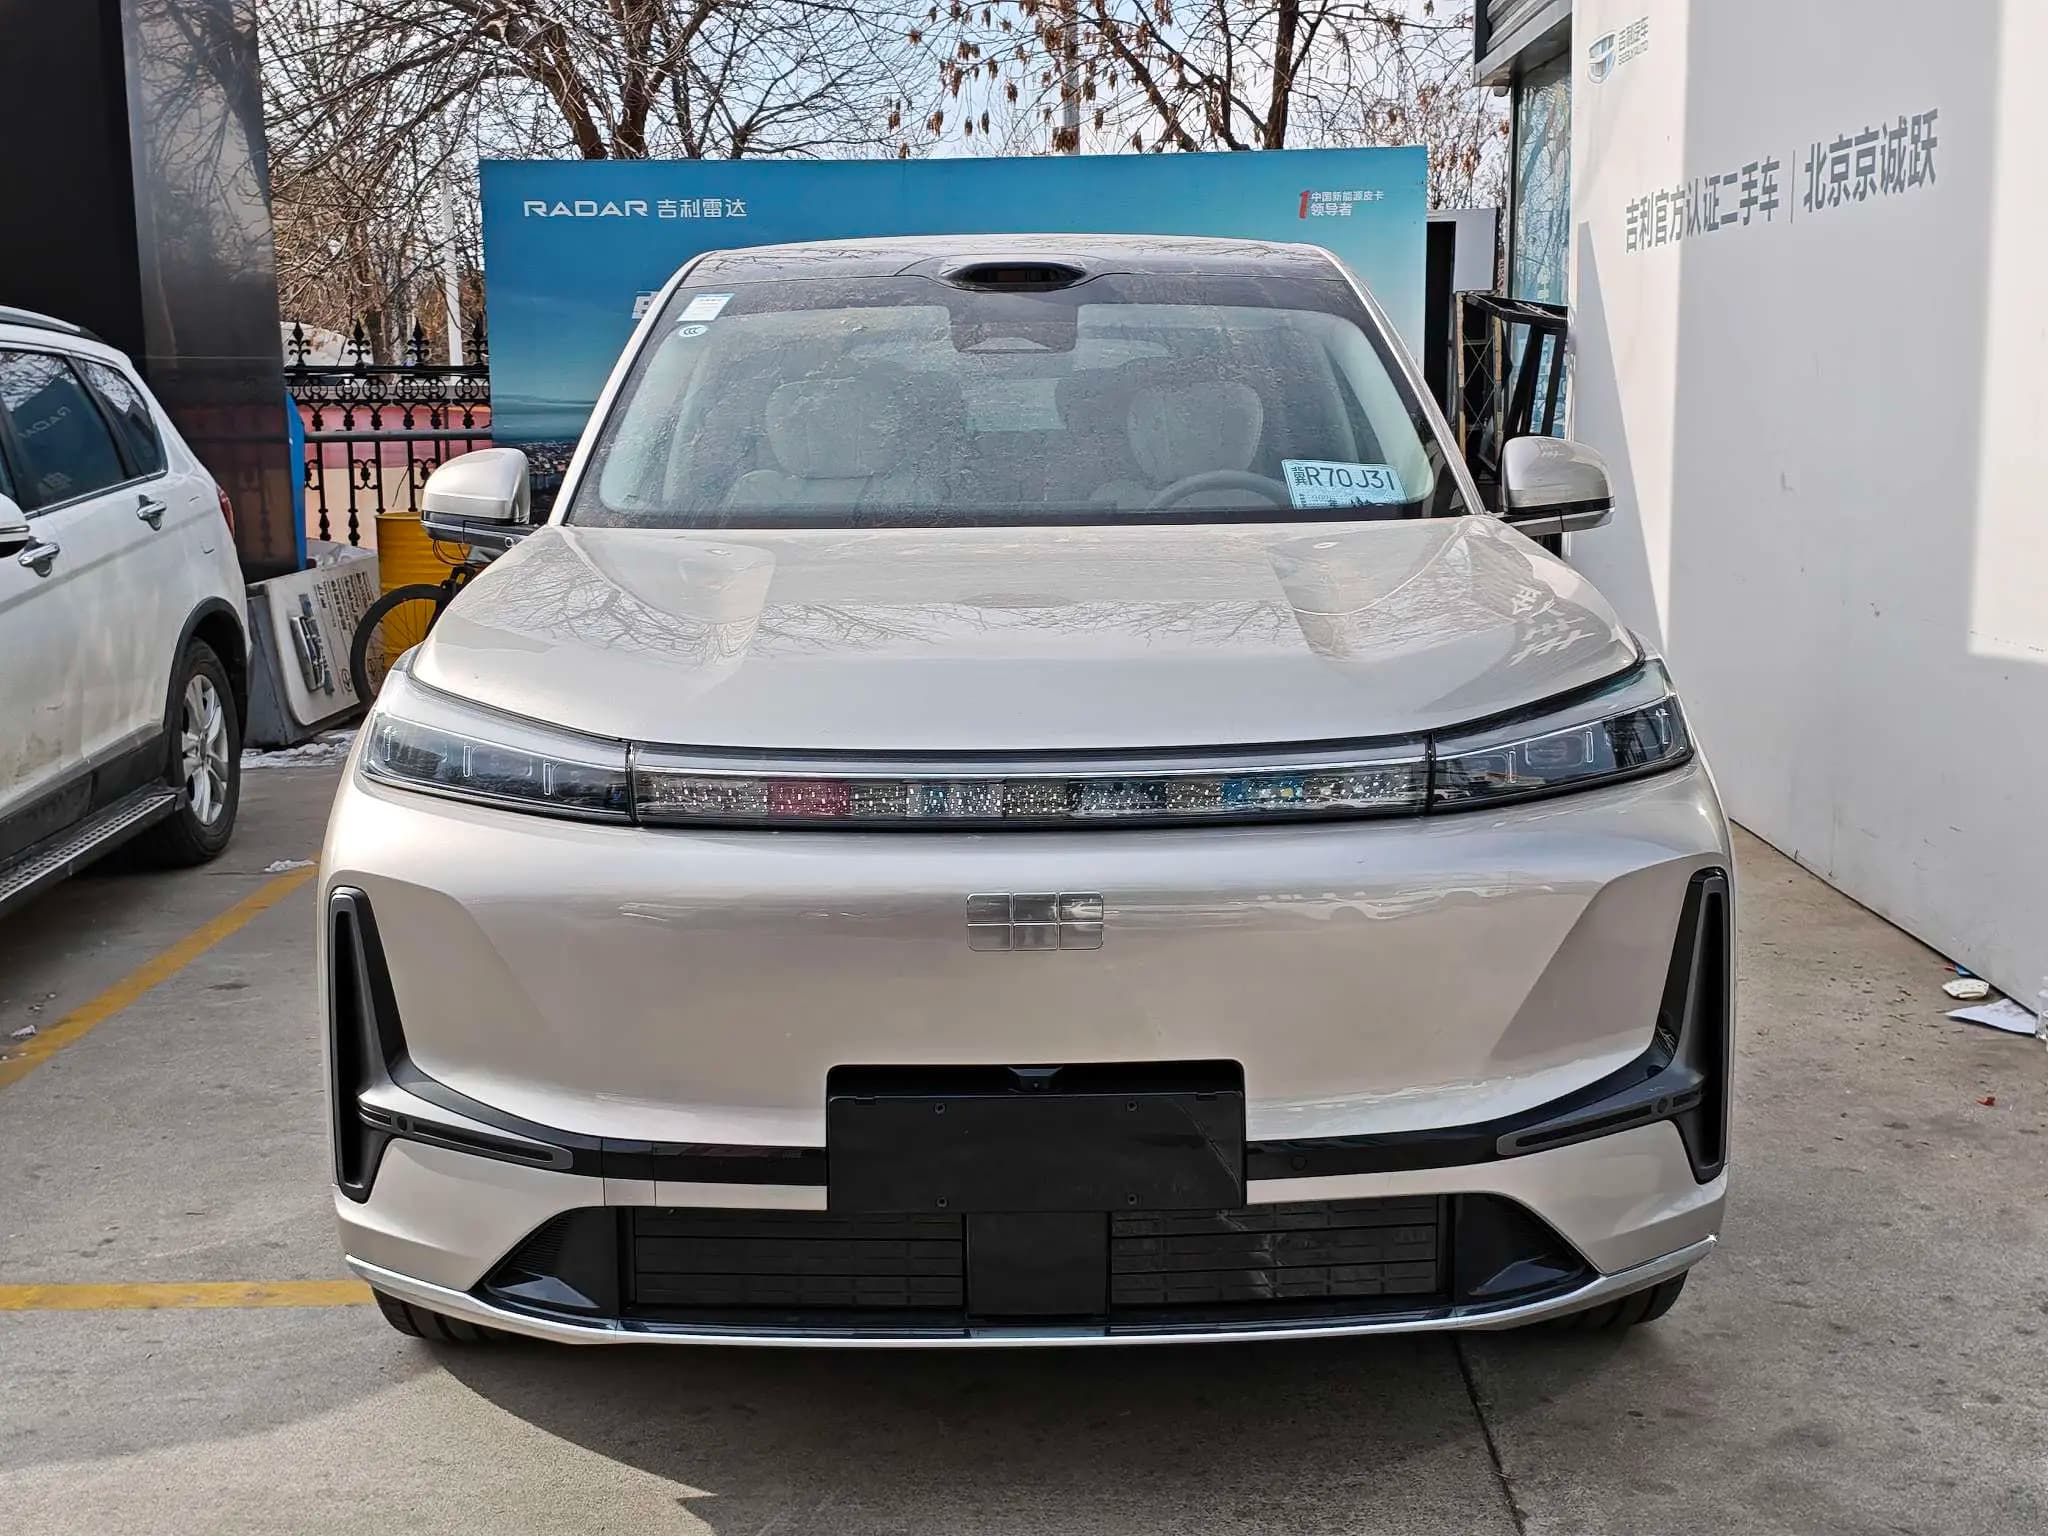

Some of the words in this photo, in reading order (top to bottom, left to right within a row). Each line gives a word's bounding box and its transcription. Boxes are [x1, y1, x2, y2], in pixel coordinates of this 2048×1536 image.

[1625, 155, 1780, 254] 吉利官方认证二手车
[1803, 108, 1938, 213] 北京京诚跃
[1311, 190, 1385, 202] 中国新能源皮卡
[523, 200, 649, 217] RADAR
[656, 198, 748, 218] 吉利雷达
[1311, 203, 1353, 216] 领导者
